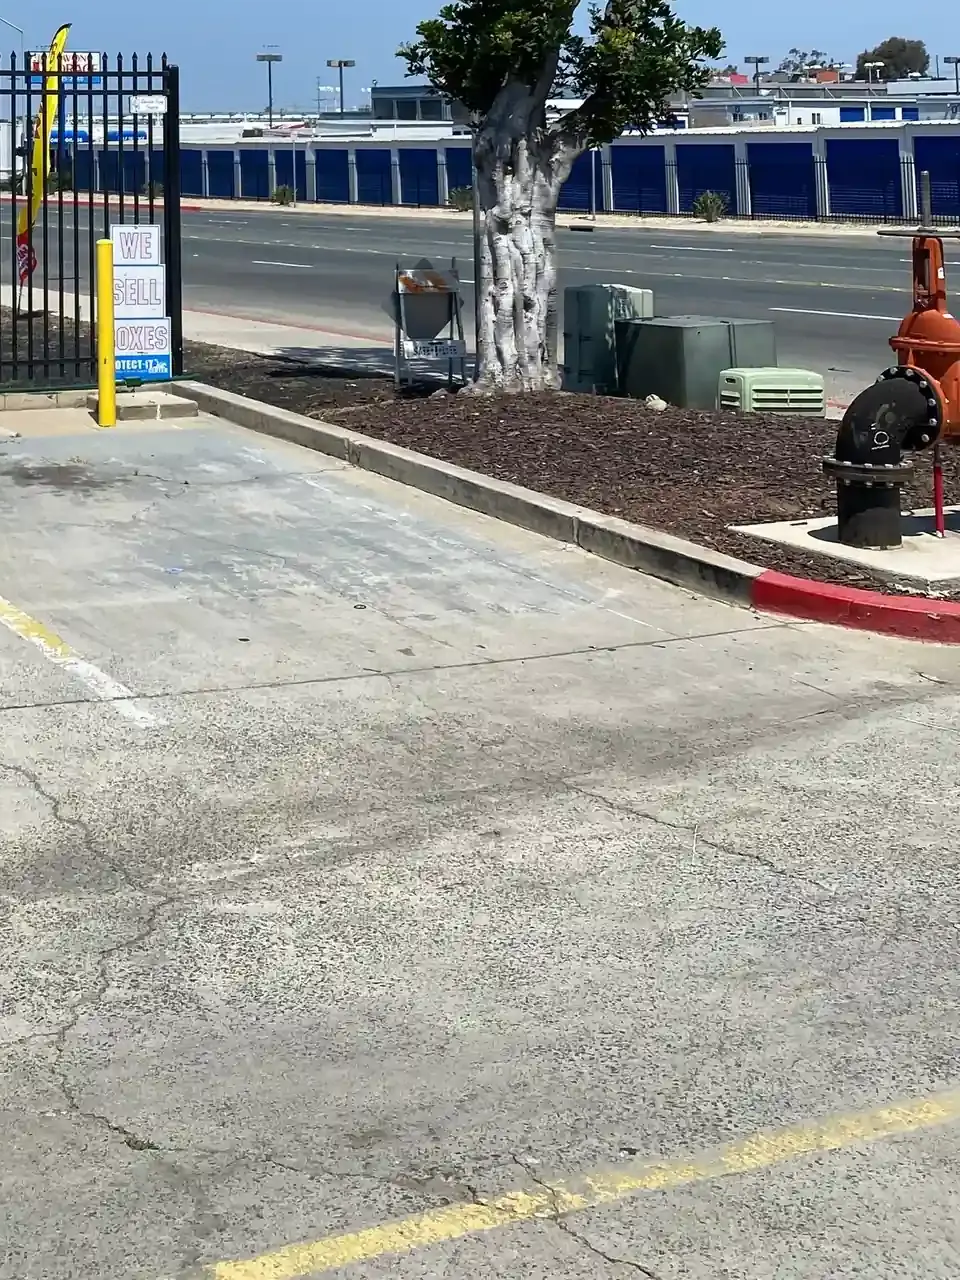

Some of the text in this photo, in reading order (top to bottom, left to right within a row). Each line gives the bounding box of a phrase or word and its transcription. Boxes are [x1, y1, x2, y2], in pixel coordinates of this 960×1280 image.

[119, 232, 152, 259] WE
[114, 278, 161, 306] SELL
[115, 326, 168, 351] OXES
[115, 359, 154, 370] OTECT-IT
